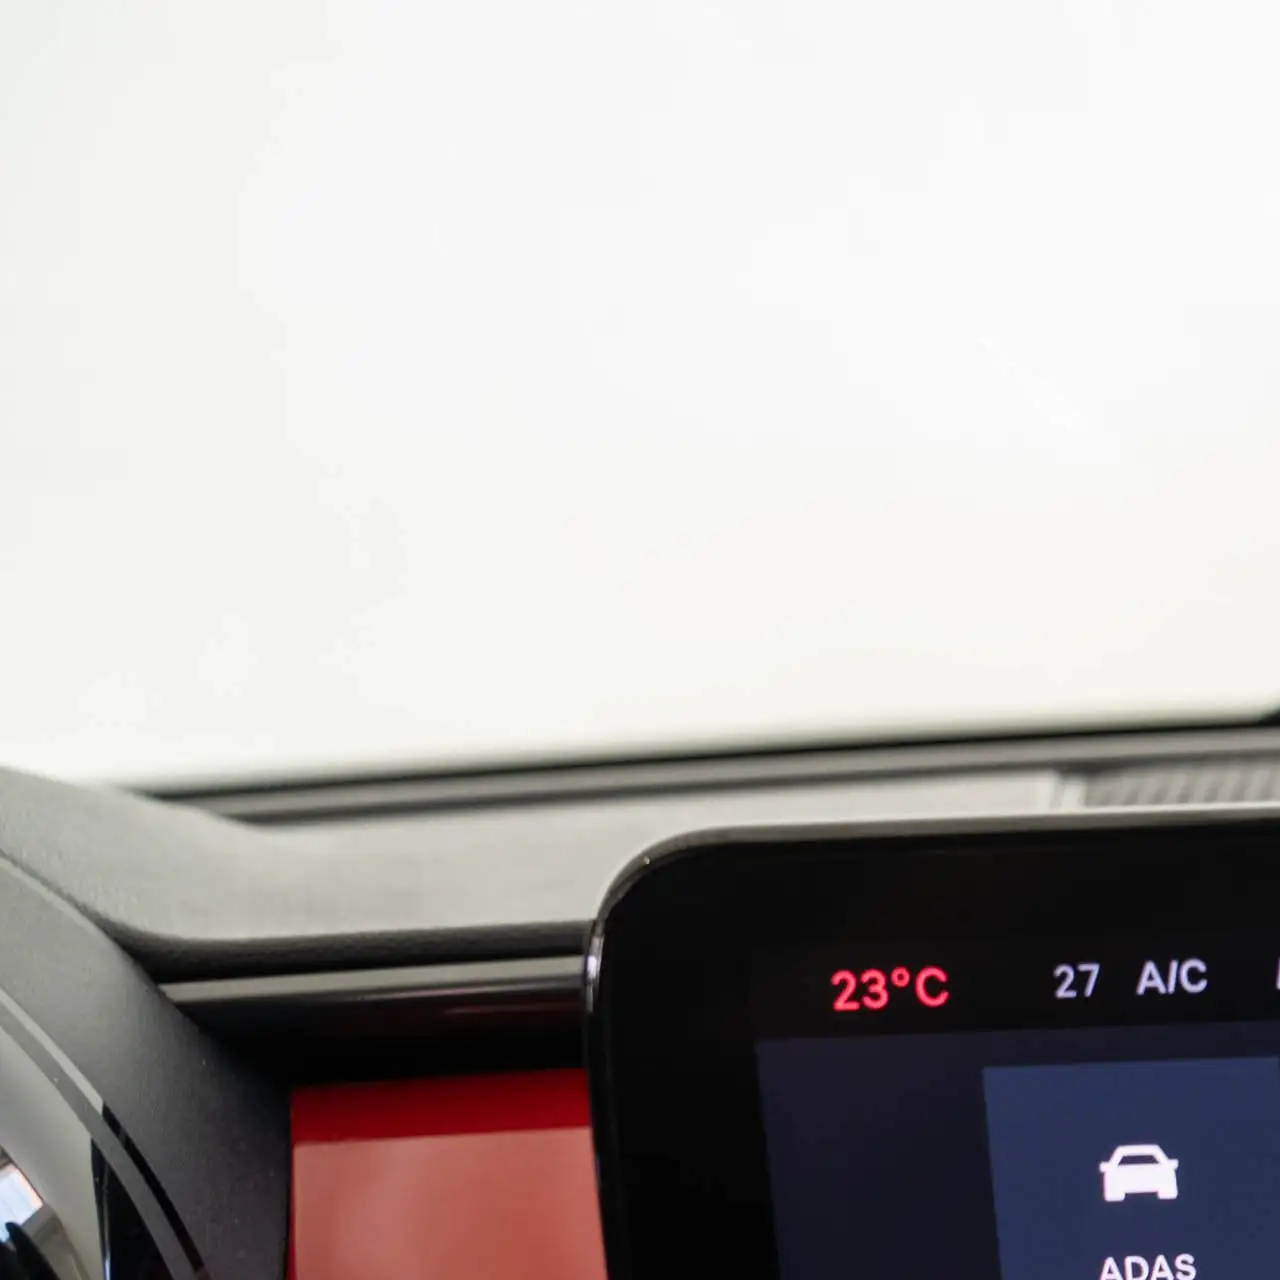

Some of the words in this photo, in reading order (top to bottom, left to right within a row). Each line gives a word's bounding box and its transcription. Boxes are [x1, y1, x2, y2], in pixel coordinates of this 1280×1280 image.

[831, 966, 950, 1011] 23°C
[1055, 963, 1100, 998] 27
[1136, 959, 1208, 995] A/C
